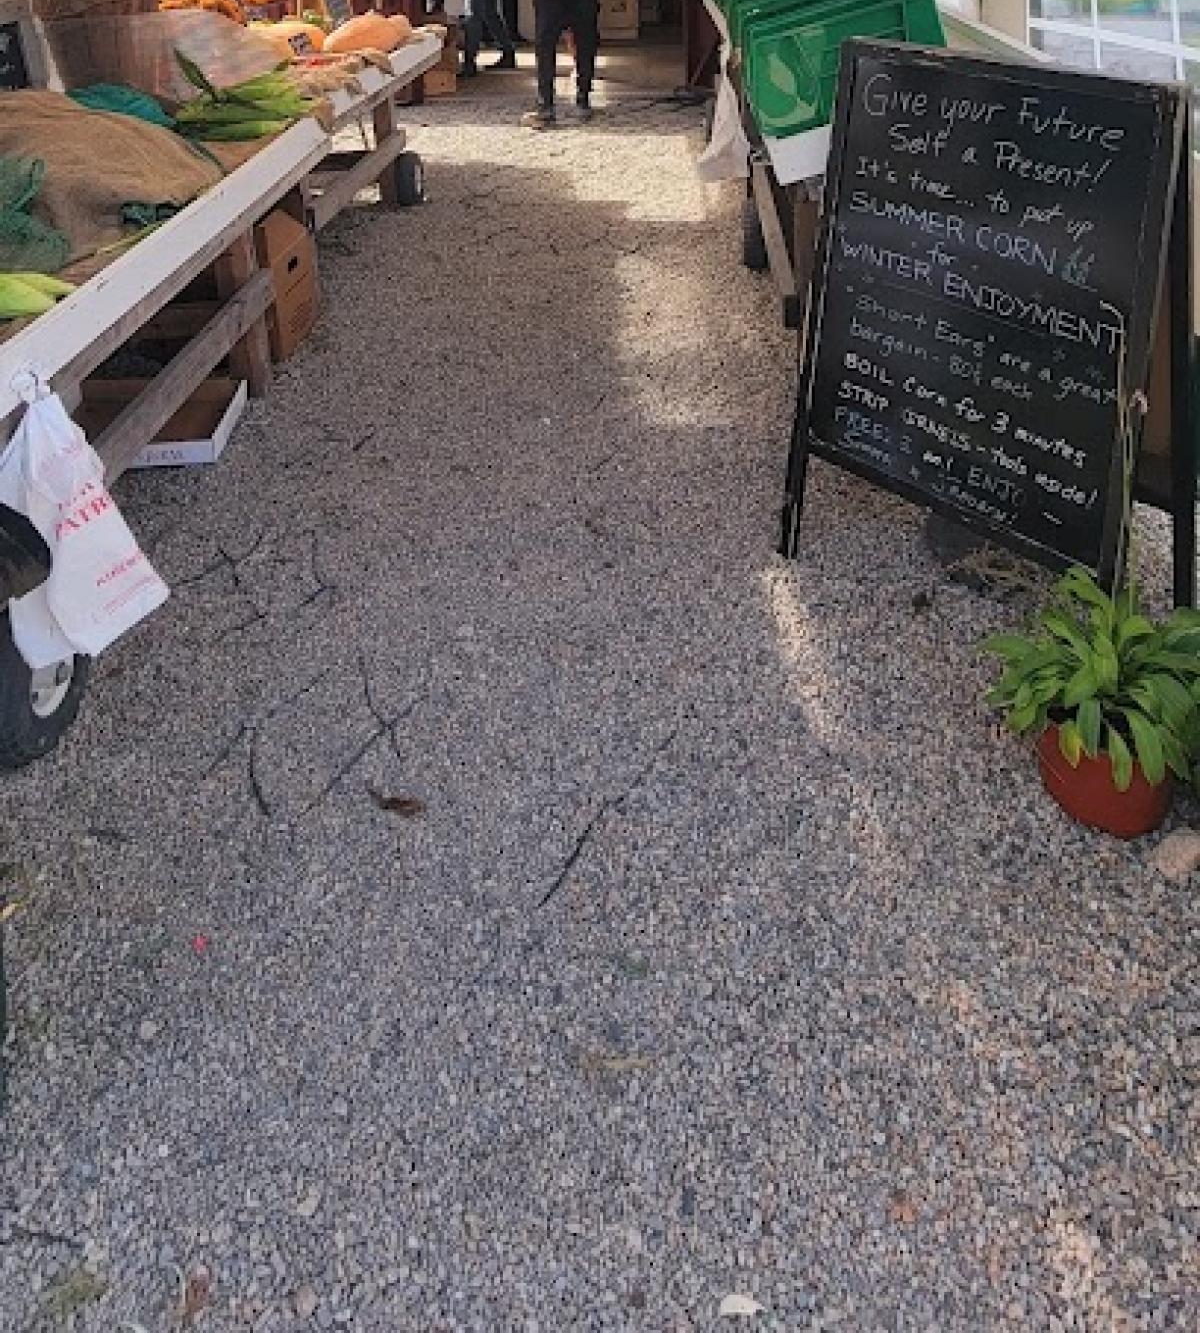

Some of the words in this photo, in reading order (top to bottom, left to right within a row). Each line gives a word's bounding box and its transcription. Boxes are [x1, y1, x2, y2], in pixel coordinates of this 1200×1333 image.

[863, 73, 927, 116] Give
[940, 97, 1006, 130] your
[1017, 97, 1124, 152] Future
[855, 156, 897, 184] It's
[985, 189, 1010, 213] to
[1017, 203, 1064, 228] put
[888, 123, 952, 156] Self
[961, 146, 978, 165] a
[994, 140, 1112, 192] Present!
[850, 191, 965, 244] SUMMER
[975, 225, 1056, 276] CORN
[927, 241, 956, 266] for
[841, 236, 934, 285] WINTER
[943, 272, 1121, 354] ENJOYMENT
[843, 353, 894, 387] BOIL
[955, 397, 986, 422] for
[991, 412, 1010, 433] 3
[1038, 366, 1052, 383] a
